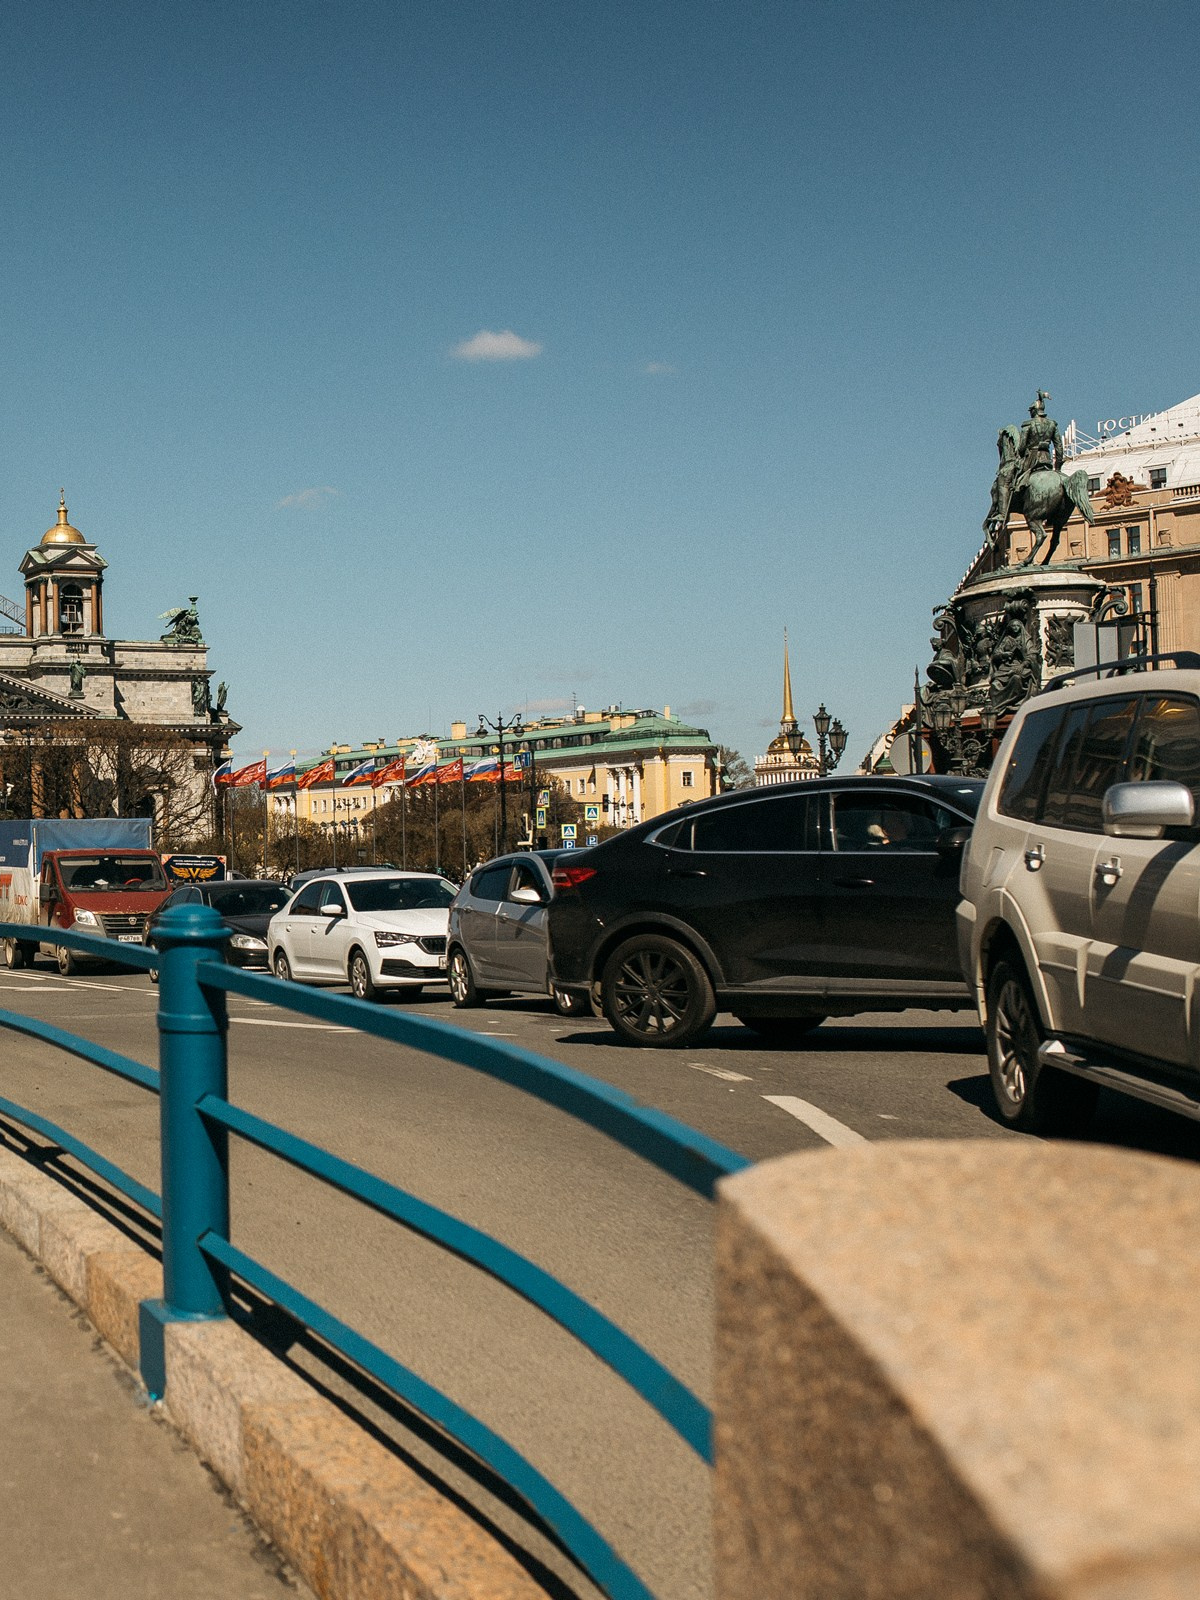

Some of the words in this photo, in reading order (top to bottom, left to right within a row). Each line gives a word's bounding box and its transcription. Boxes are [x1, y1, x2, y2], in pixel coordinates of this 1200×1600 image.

[1097, 411, 1161, 433] ГОСТИ
[566, 841, 573, 849] P
[188, 867, 201, 879] V
